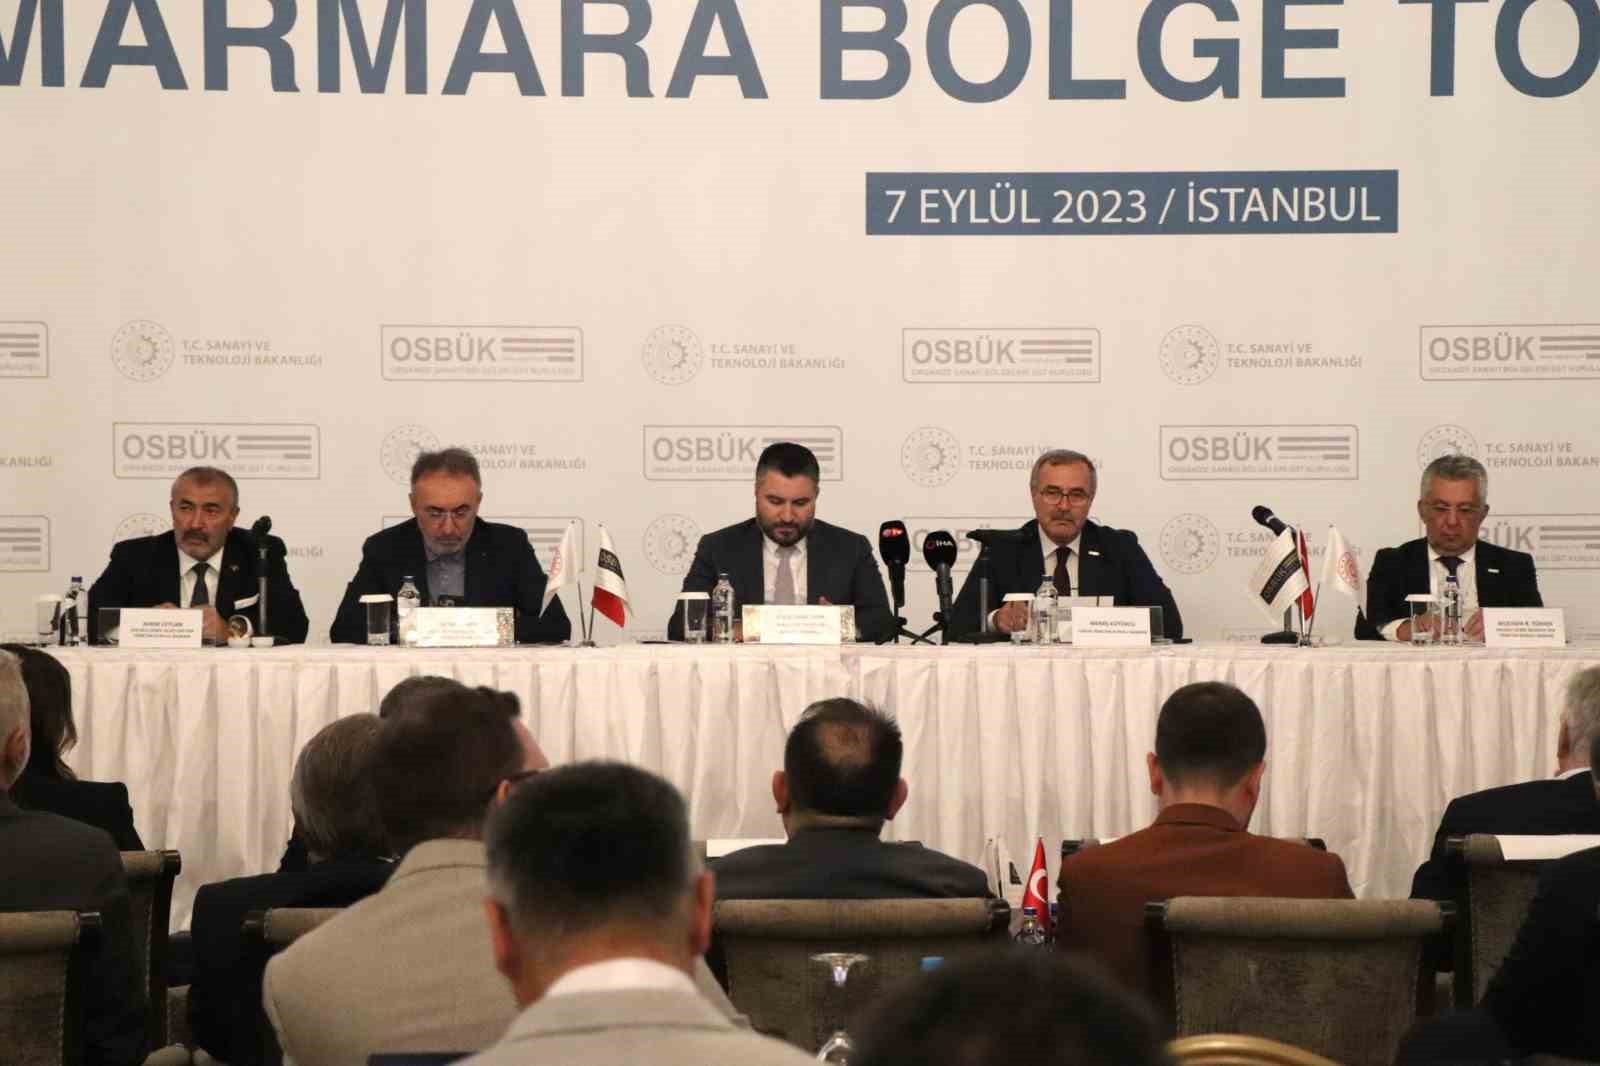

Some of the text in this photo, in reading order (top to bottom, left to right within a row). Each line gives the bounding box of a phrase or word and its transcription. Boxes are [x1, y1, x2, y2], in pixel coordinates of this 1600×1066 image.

[885, 181, 1381, 225] 7 EYLÜL 2023 / İSTANBUL
[255, 340, 272, 351] VE
[390, 332, 497, 362] OSBÜK
[780, 344, 796, 354] VE
[912, 335, 1016, 364] OSBÜK
[1297, 343, 1313, 353] VE
[1429, 331, 1535, 361] OSBÜK
[122, 430, 233, 460] OSBÜK
[520, 444, 537, 456] VE
[653, 432, 757, 462] OSBÜK
[1169, 432, 1273, 462] OSBÜK
[1557, 442, 1574, 453] VE
